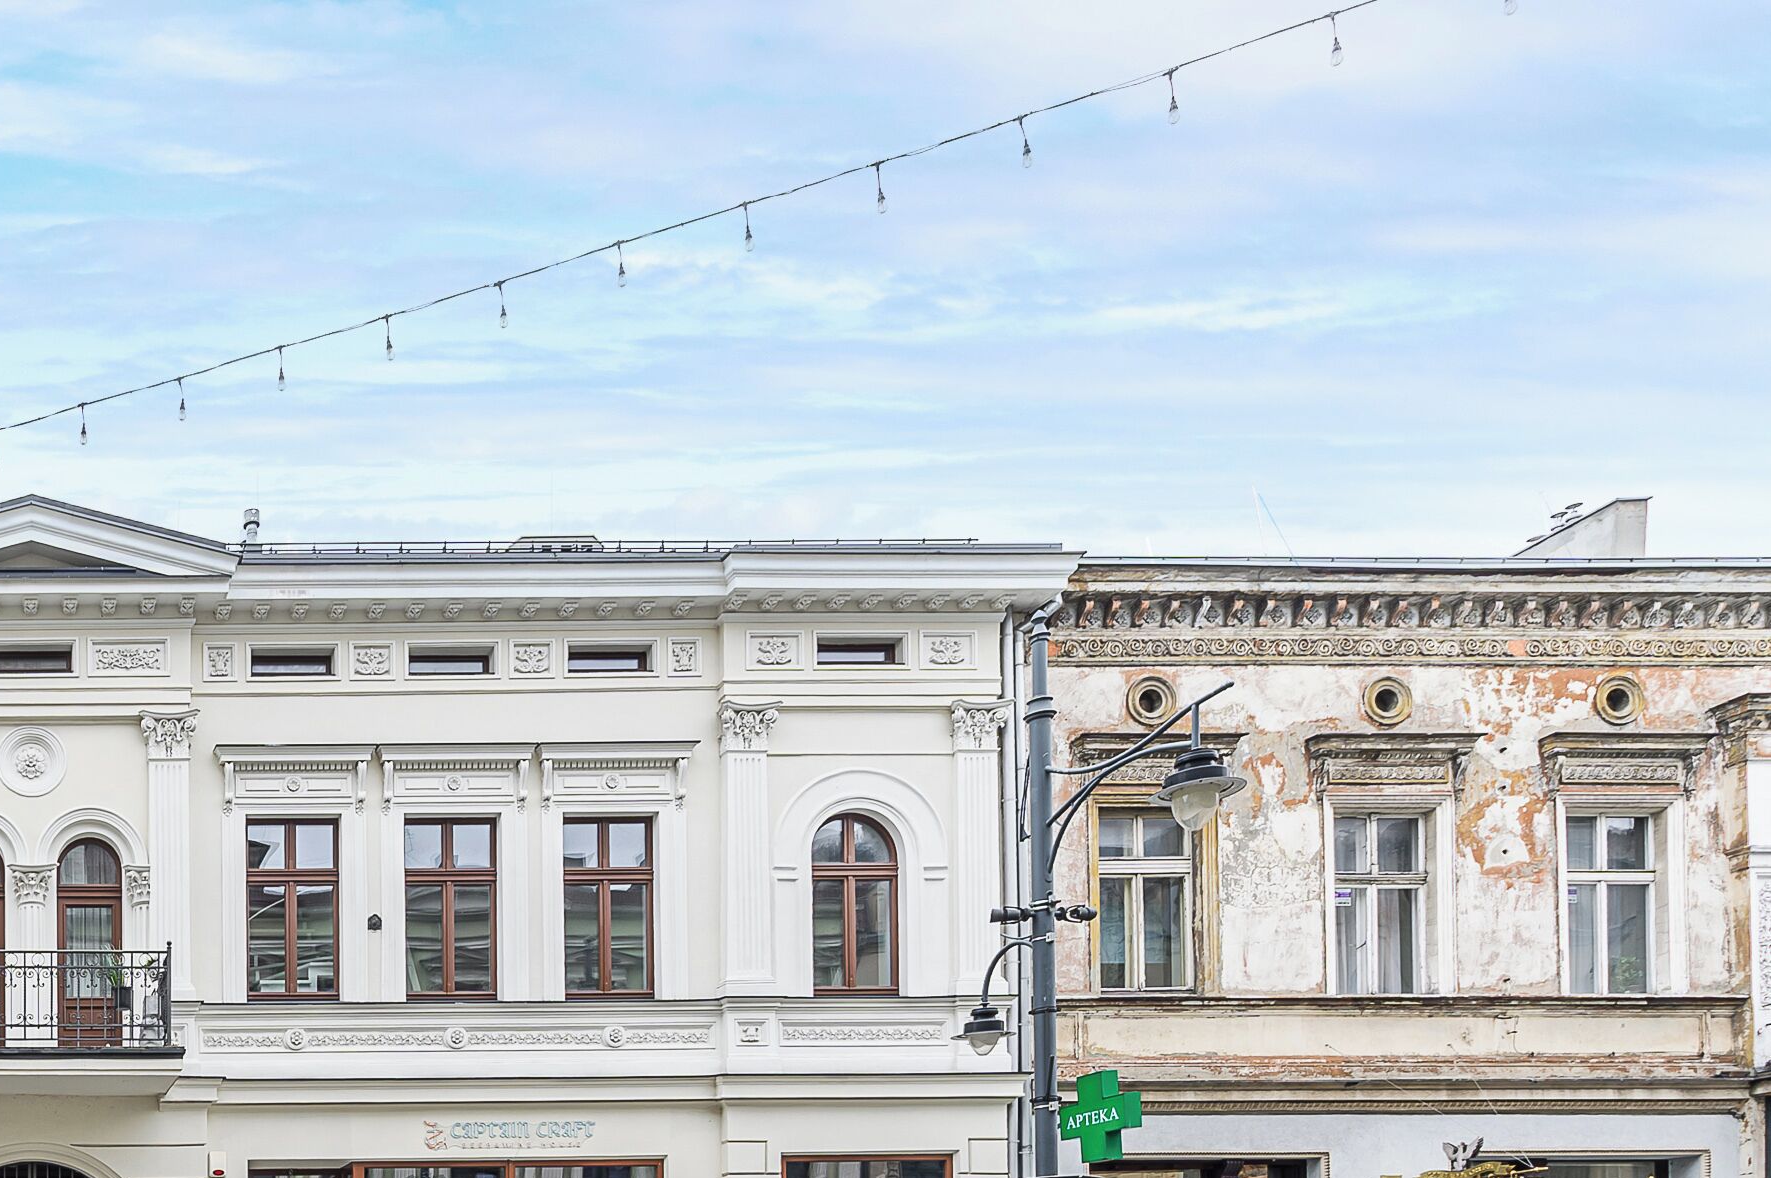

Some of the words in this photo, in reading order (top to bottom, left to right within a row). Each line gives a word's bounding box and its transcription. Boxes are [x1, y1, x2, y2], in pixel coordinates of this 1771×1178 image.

[1066, 1106, 1120, 1130] APTEKA
[450, 1121, 530, 1140] CAPTAIN
[535, 1120, 596, 1139] CRAFT
